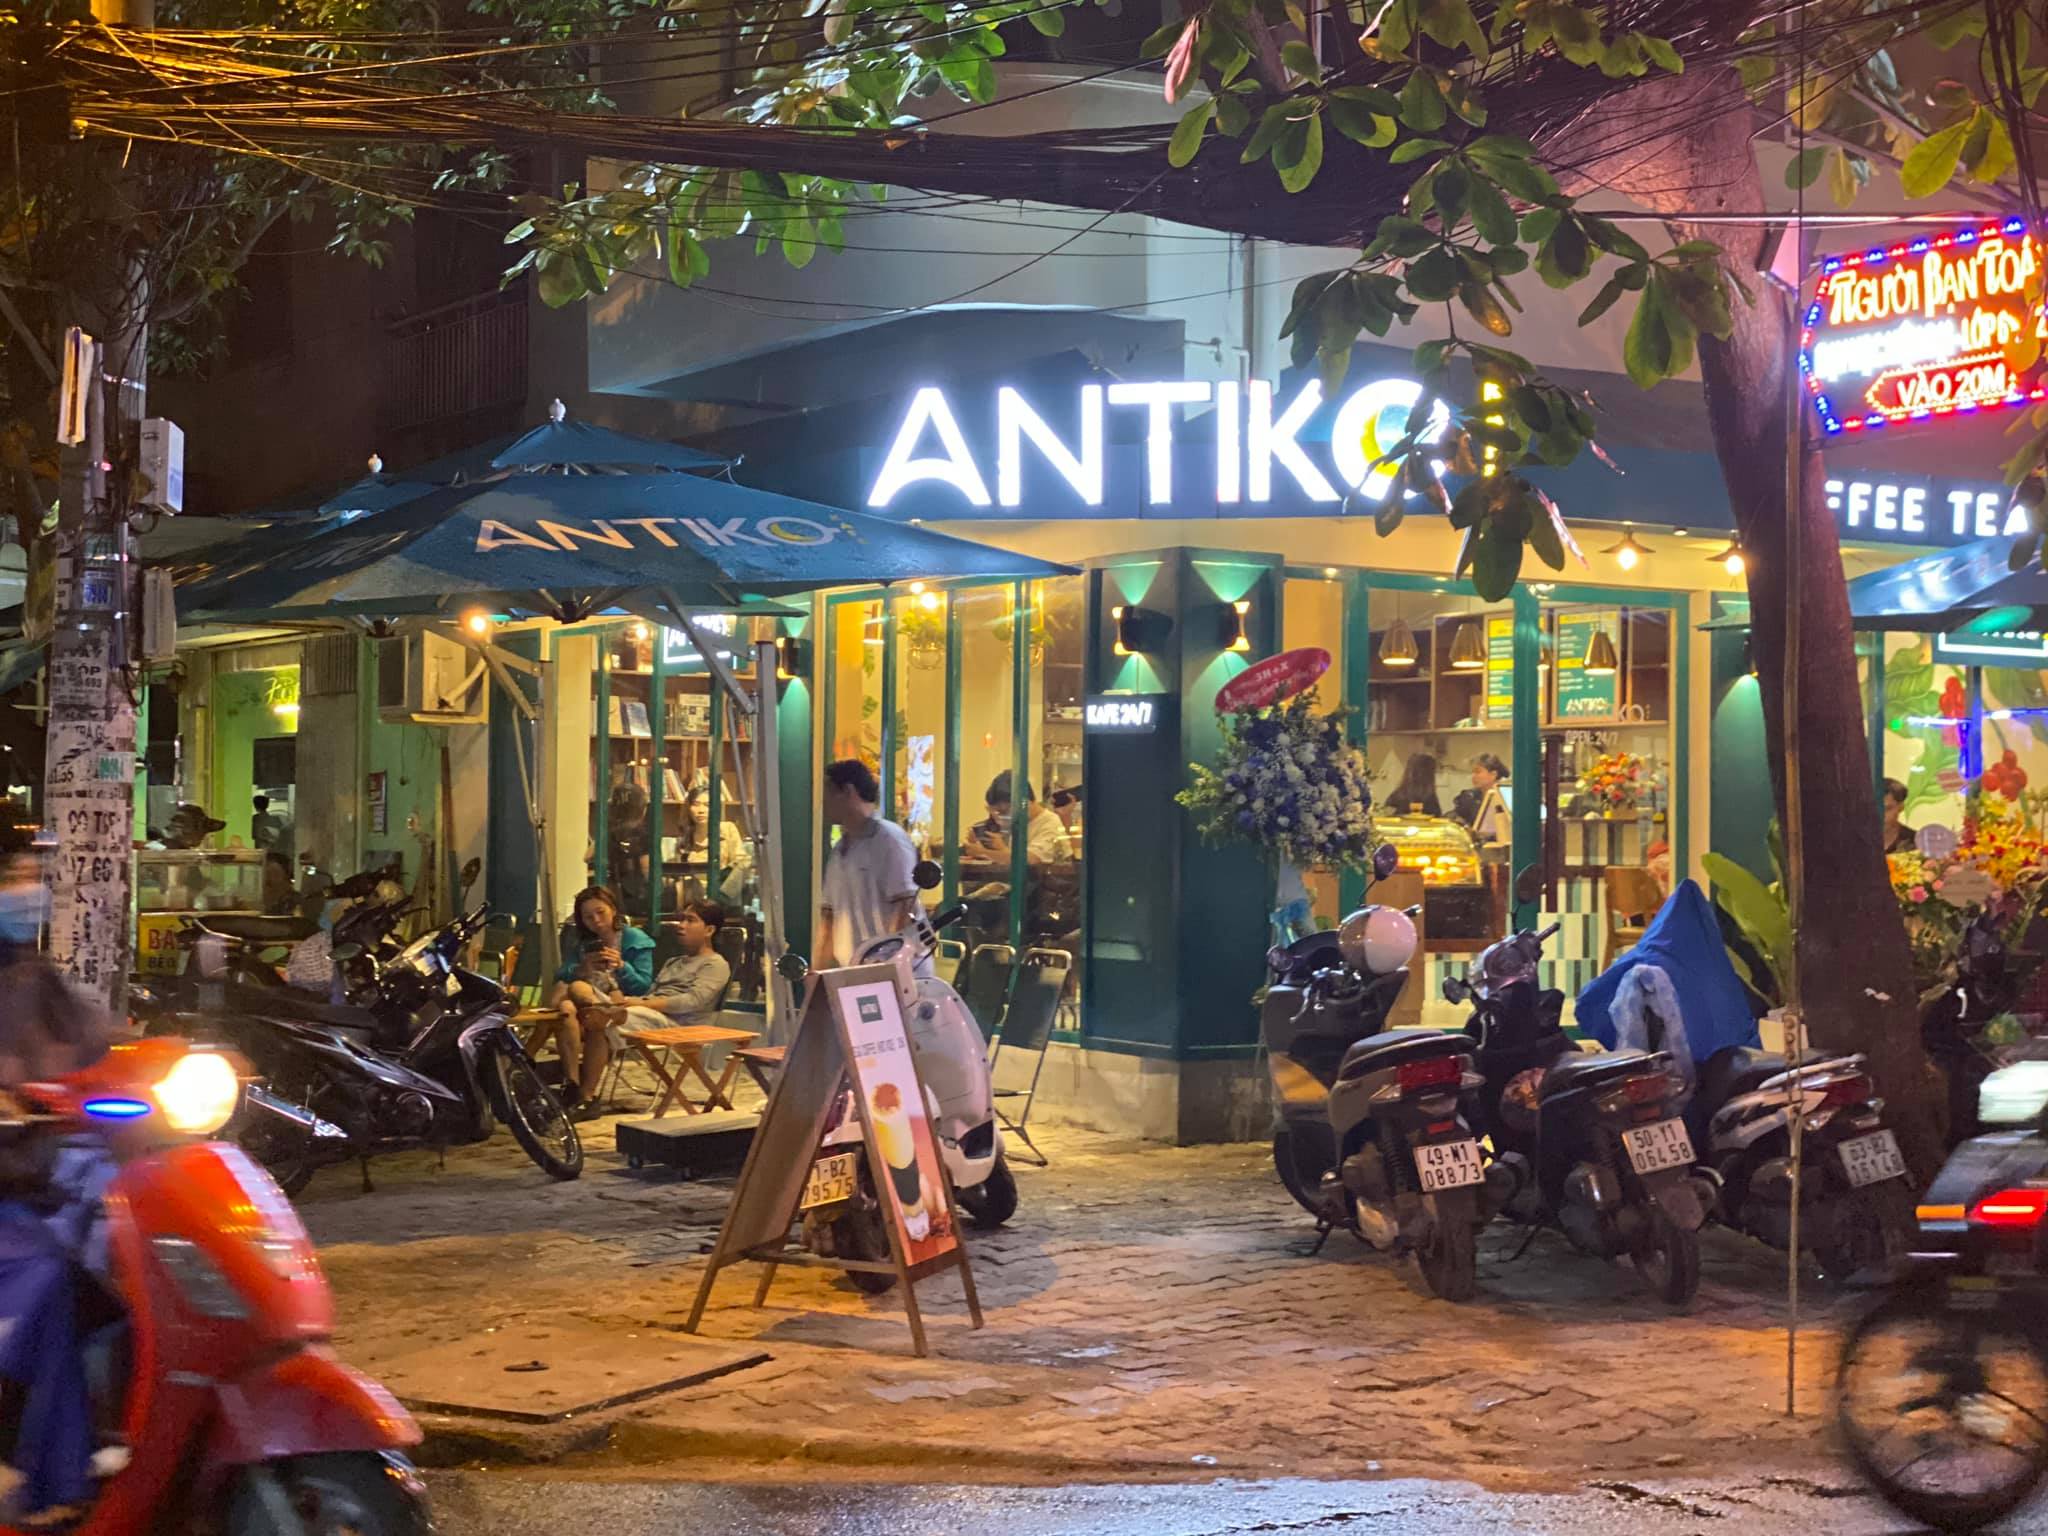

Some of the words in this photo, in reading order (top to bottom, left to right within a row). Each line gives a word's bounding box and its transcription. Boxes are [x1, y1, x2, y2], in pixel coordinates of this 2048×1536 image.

[1896, 370, 1952, 407] VÀO
[1954, 362, 2006, 400] 20M
[867, 378, 1450, 506] ANTIKO
[1947, 490, 2030, 536] TEA
[475, 516, 841, 553] ANTIKO
[1633, 1122, 1678, 1149] 50-Y1
[1426, 1143, 1469, 1166] 49-N1
[1635, 1143, 1691, 1171] 064.58
[1424, 1163, 1481, 1188] 088.73
